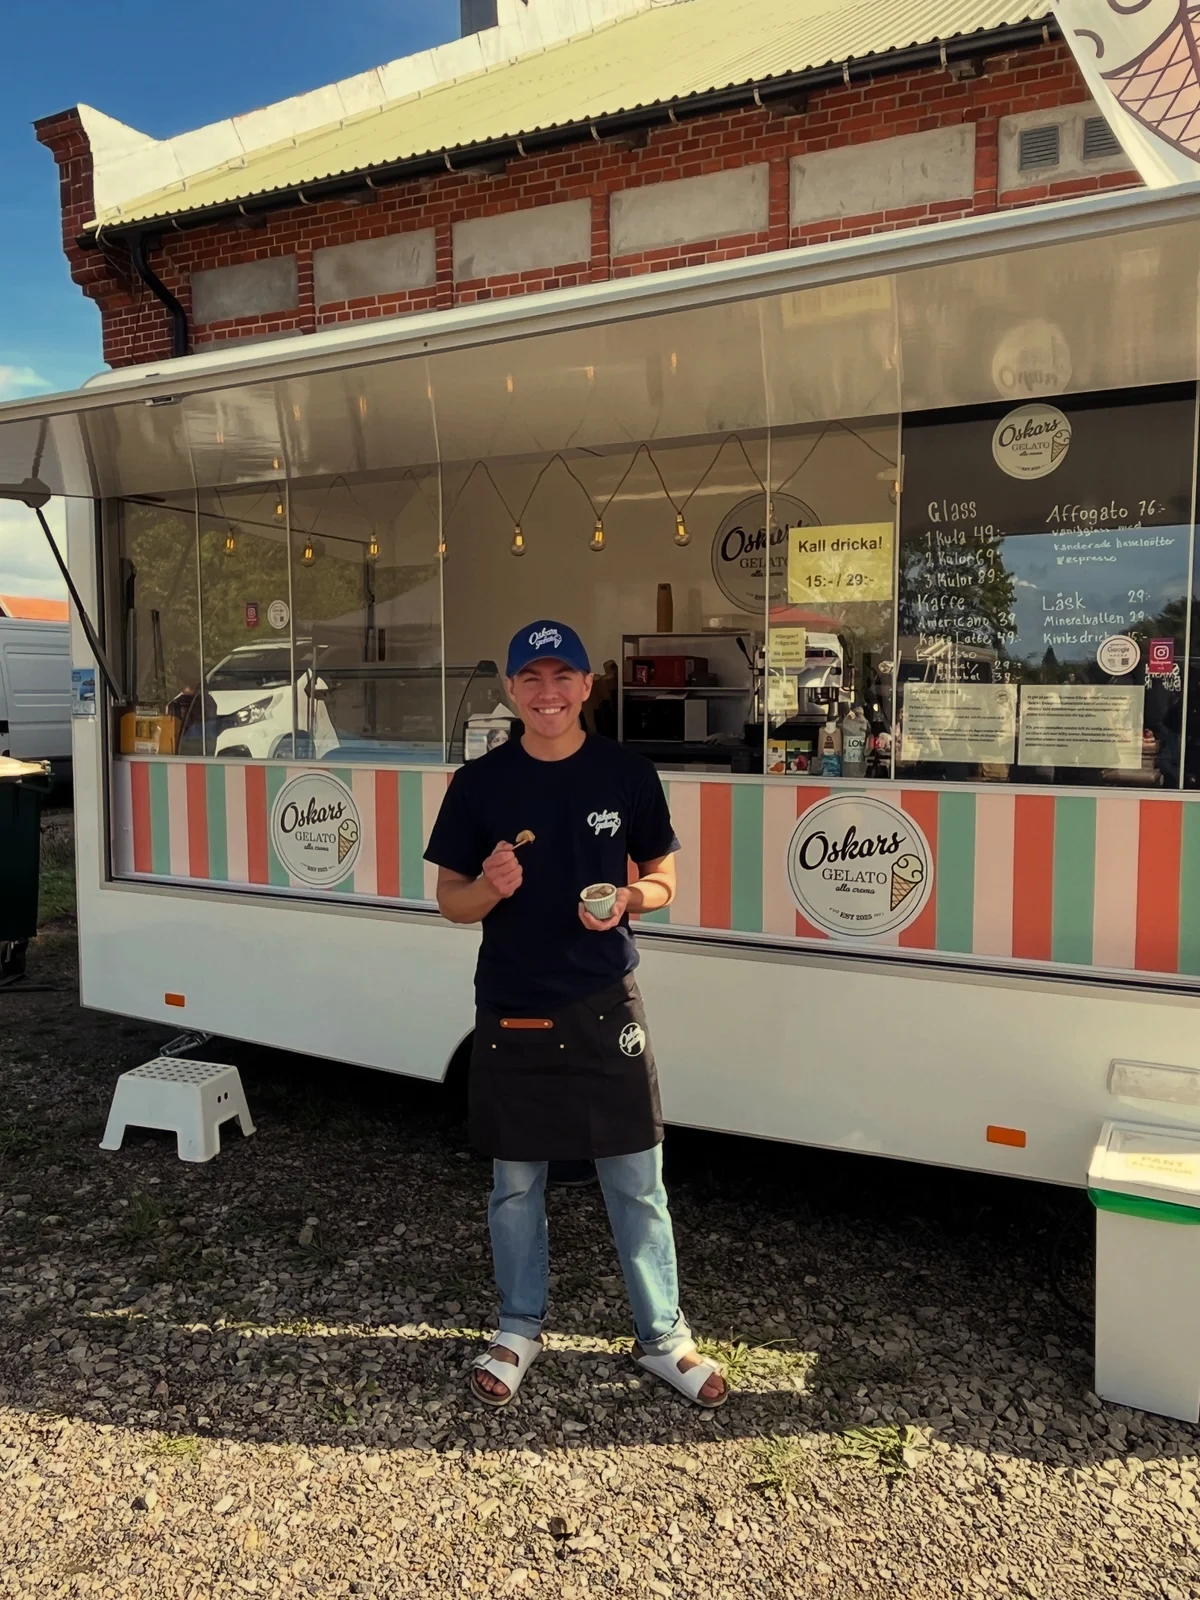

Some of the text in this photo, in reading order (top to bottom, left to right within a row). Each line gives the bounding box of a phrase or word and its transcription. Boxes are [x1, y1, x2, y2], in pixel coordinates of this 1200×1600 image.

[999, 418, 1061, 447] Oskars
[1012, 442, 1050, 451] GELATO
[928, 500, 977, 522] Glass
[1046, 499, 1165, 525] Affogato 76:-
[1118, 521, 1142, 532] med
[721, 519, 802, 561] Oskar
[798, 536, 883, 554] Kall dricka!
[936, 528, 967, 546] Kula
[806, 573, 875, 588] 15:- / 29:-
[917, 594, 965, 612] Kaffe
[918, 615, 989, 629] Americano
[1044, 613, 1124, 627] Mineralvatten
[920, 632, 952, 647] Kaffe
[956, 631, 992, 645] Latte
[1043, 633, 1078, 645] Kiviks
[280, 797, 347, 834] Oskars
[295, 831, 337, 844] GELATO
[799, 825, 907, 870] Oskars
[822, 868, 887, 885] GELATO
[835, 883, 850, 893] alla
[839, 912, 873, 921] EST 2025
